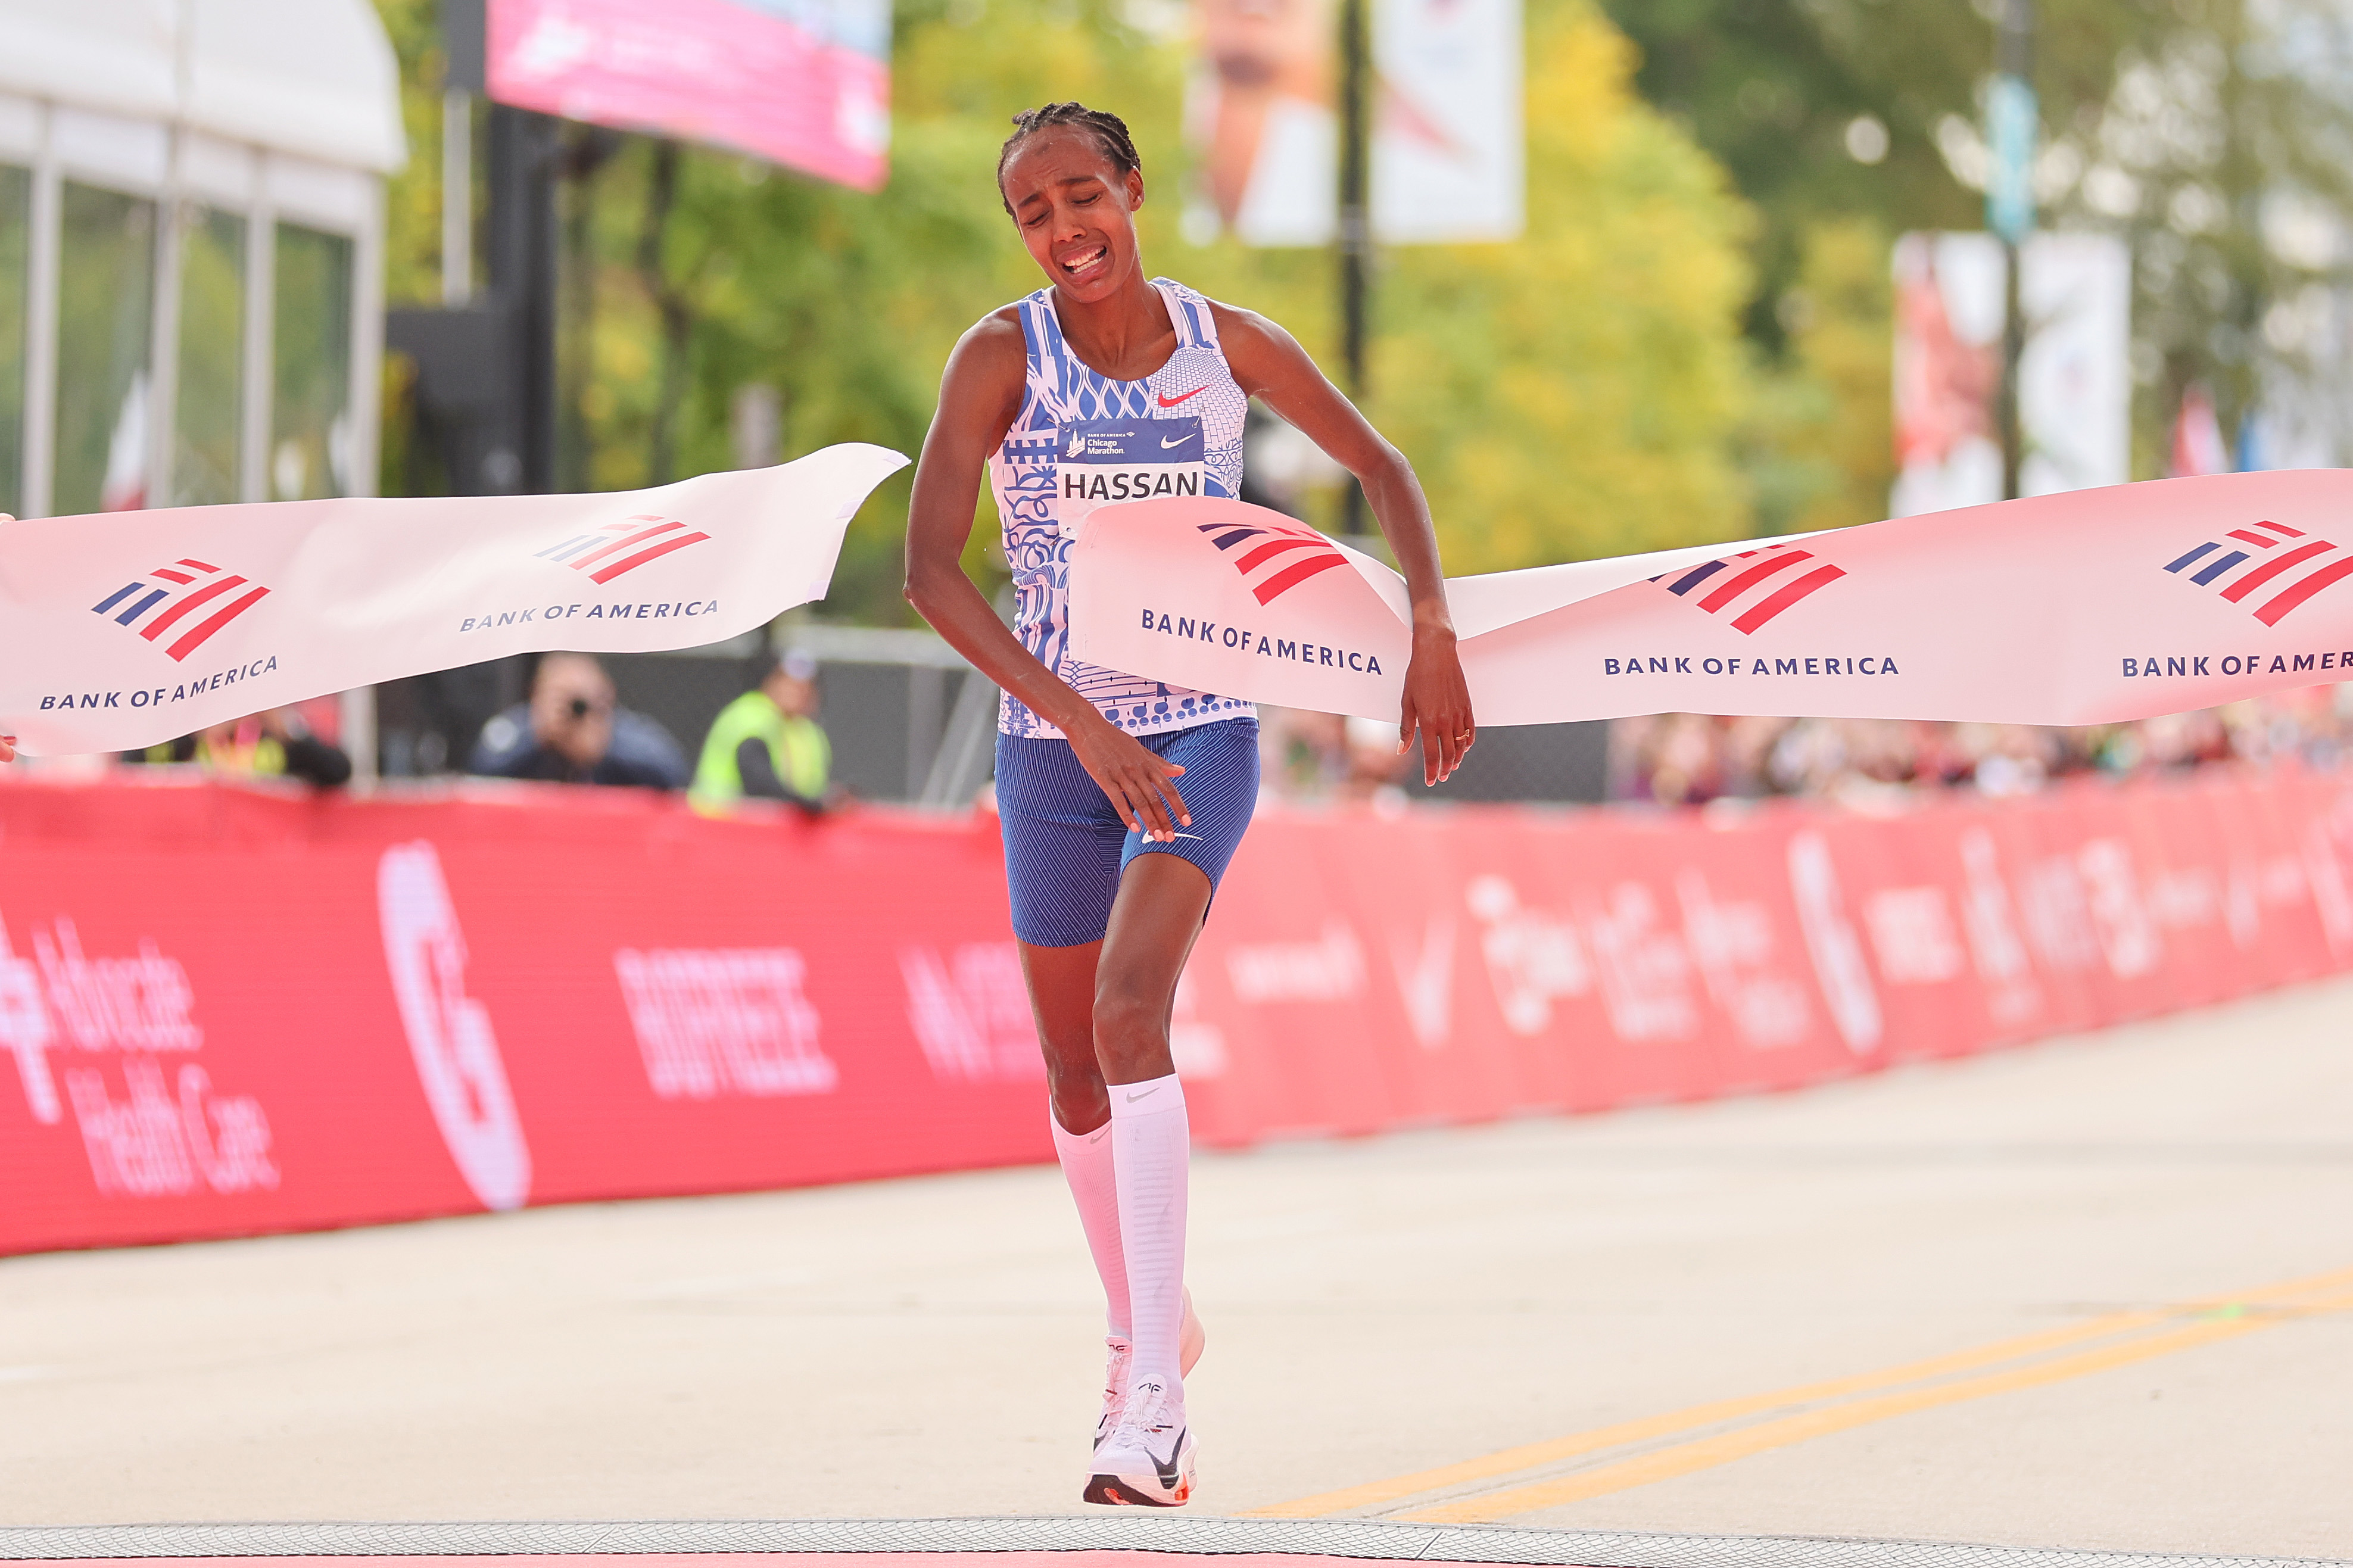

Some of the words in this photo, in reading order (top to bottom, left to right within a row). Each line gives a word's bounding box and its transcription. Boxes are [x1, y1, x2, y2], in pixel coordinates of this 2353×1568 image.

[1087, 439, 1117, 448] Chicago
[1065, 472, 1198, 501] HASSAN
[459, 607, 538, 632] BANK
[544, 604, 582, 620] OF
[585, 600, 718, 619] AMERICA
[1142, 609, 1216, 643] BANK
[1223, 627, 1252, 650] OF
[1256, 635, 1382, 676] AMERICA
[1604, 657, 1693, 675] BANK
[1702, 657, 1741, 675] OF
[1751, 657, 1899, 675] AMERICA
[2122, 656, 2210, 677] BANK
[2221, 656, 2261, 675] OF
[39, 691, 121, 710] BANK
[130, 688, 166, 707] OF
[170, 655, 278, 703] AMERICA
